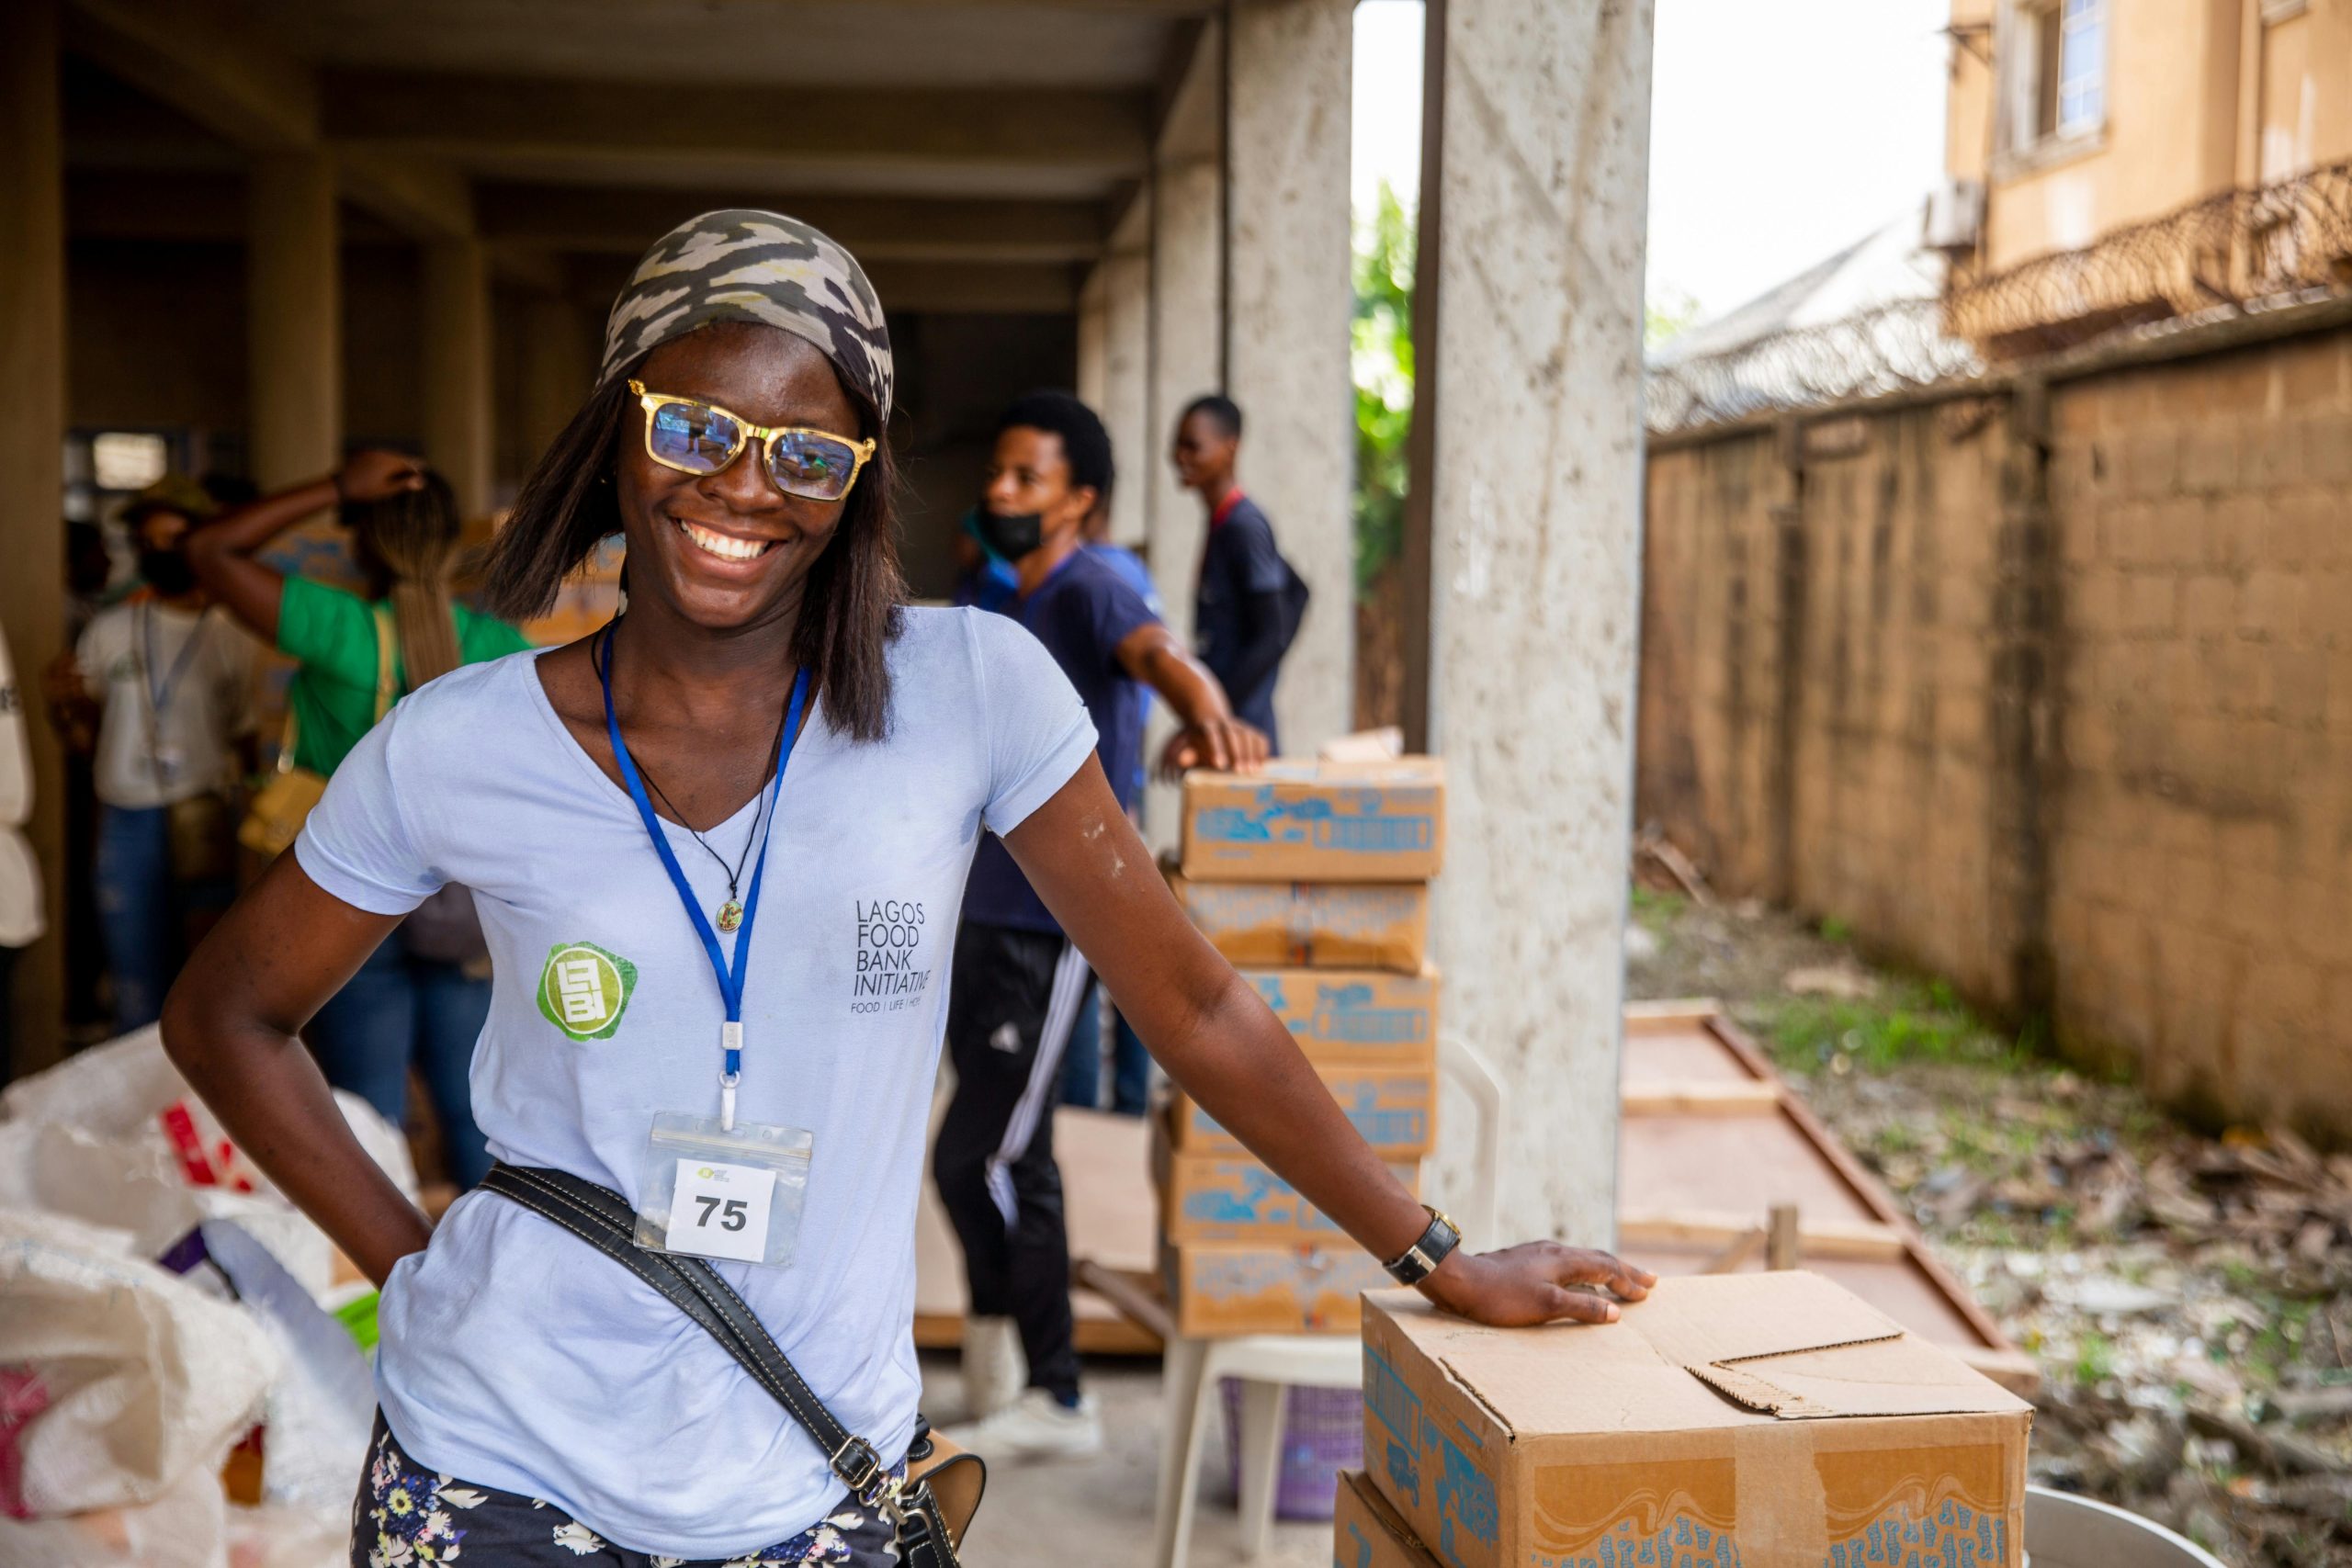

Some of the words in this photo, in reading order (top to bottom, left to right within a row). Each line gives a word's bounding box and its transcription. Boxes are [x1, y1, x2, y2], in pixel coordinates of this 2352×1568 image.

[856, 899, 925, 925] LAGOS
[857, 923, 920, 948] FOOD
[856, 949, 913, 972] BANK
[851, 1001, 881, 1014] FOOD
[888, 998, 904, 1011] LIFE
[695, 1195, 748, 1232] 75
